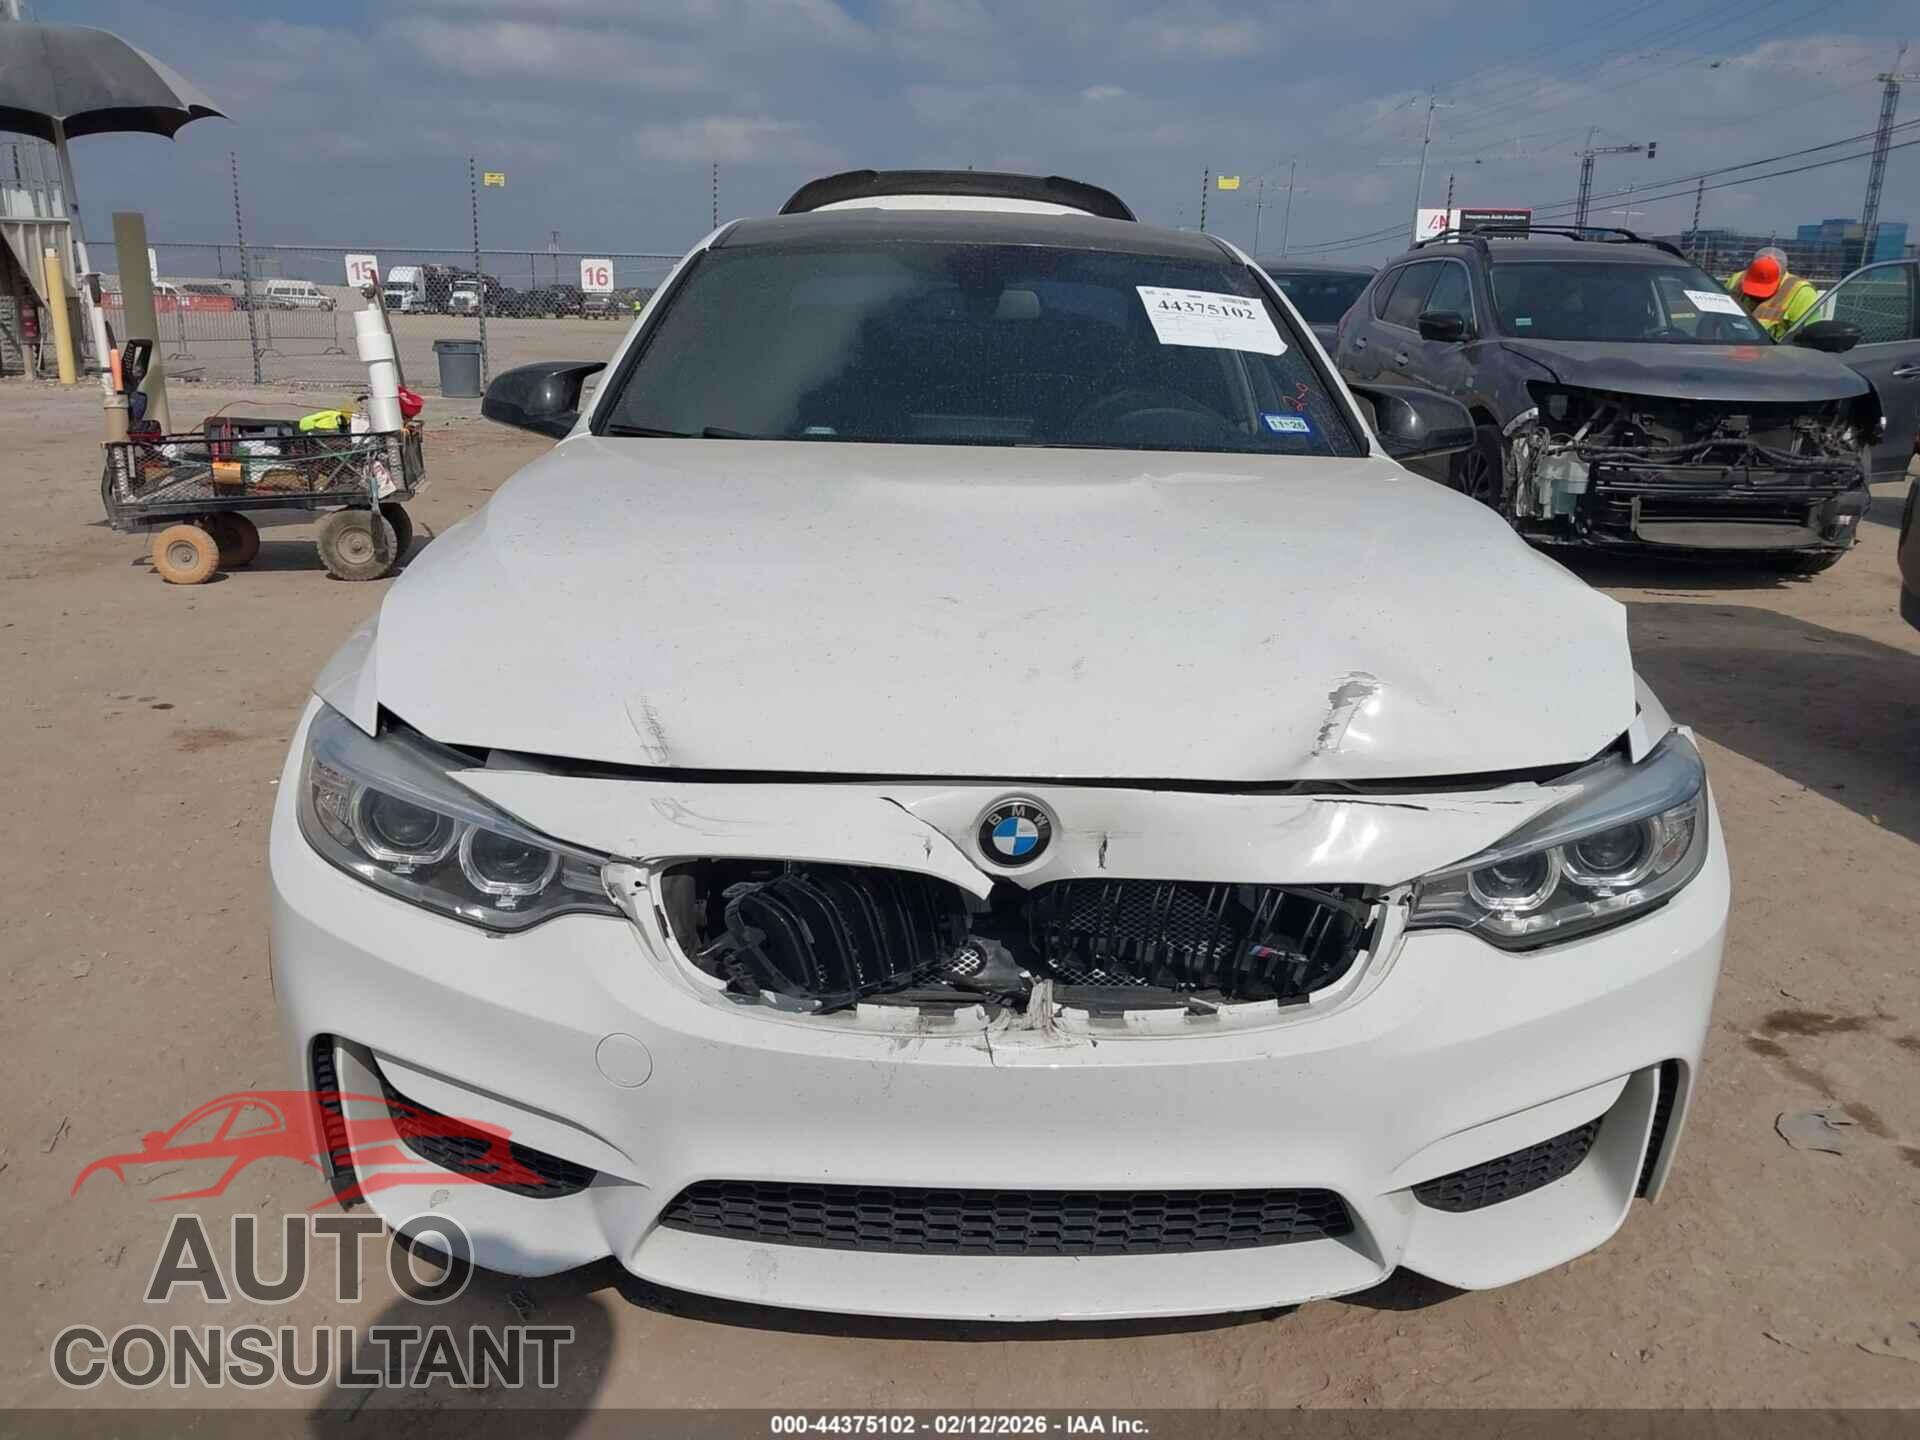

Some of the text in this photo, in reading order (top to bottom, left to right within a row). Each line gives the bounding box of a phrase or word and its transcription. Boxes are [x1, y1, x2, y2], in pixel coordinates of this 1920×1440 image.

[350, 260, 374, 281] 15
[584, 266, 609, 287] 16
[1157, 299, 1256, 320] 44375102
[987, 805, 1048, 827] BMW
